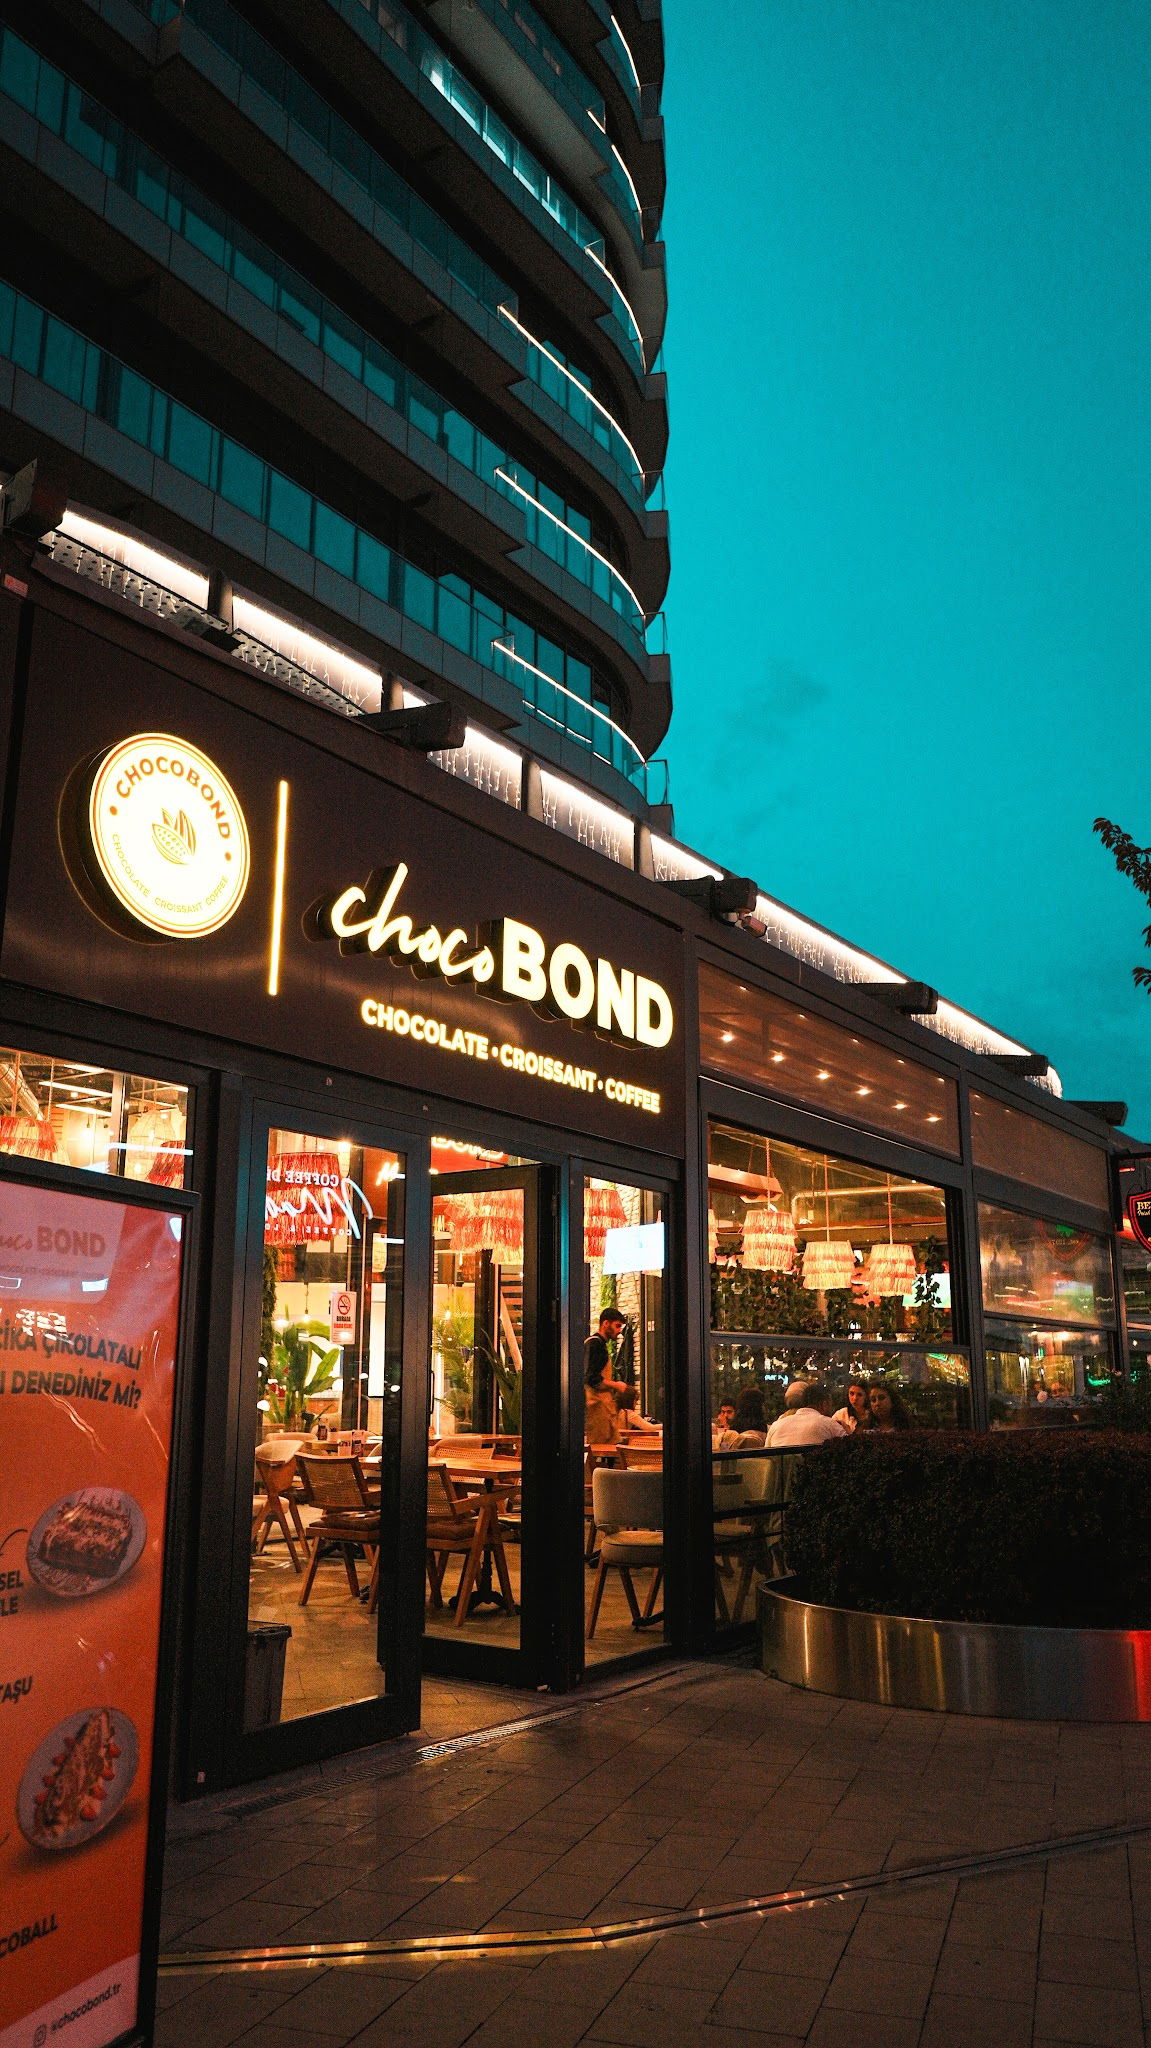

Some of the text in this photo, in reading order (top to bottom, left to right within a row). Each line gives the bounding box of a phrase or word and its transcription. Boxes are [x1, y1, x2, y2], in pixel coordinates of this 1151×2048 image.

[116, 757, 231, 839] CHOCOBOND
[112, 833, 230, 914] CHOCOLATE CROISSANT COFFEE
[361, 998, 661, 1115] CHOCOLATE CROISSANT COFFEE
[11, 1368, 112, 1402] DENEDİNİZ
[113, 1380, 142, 1409] Mİ?
